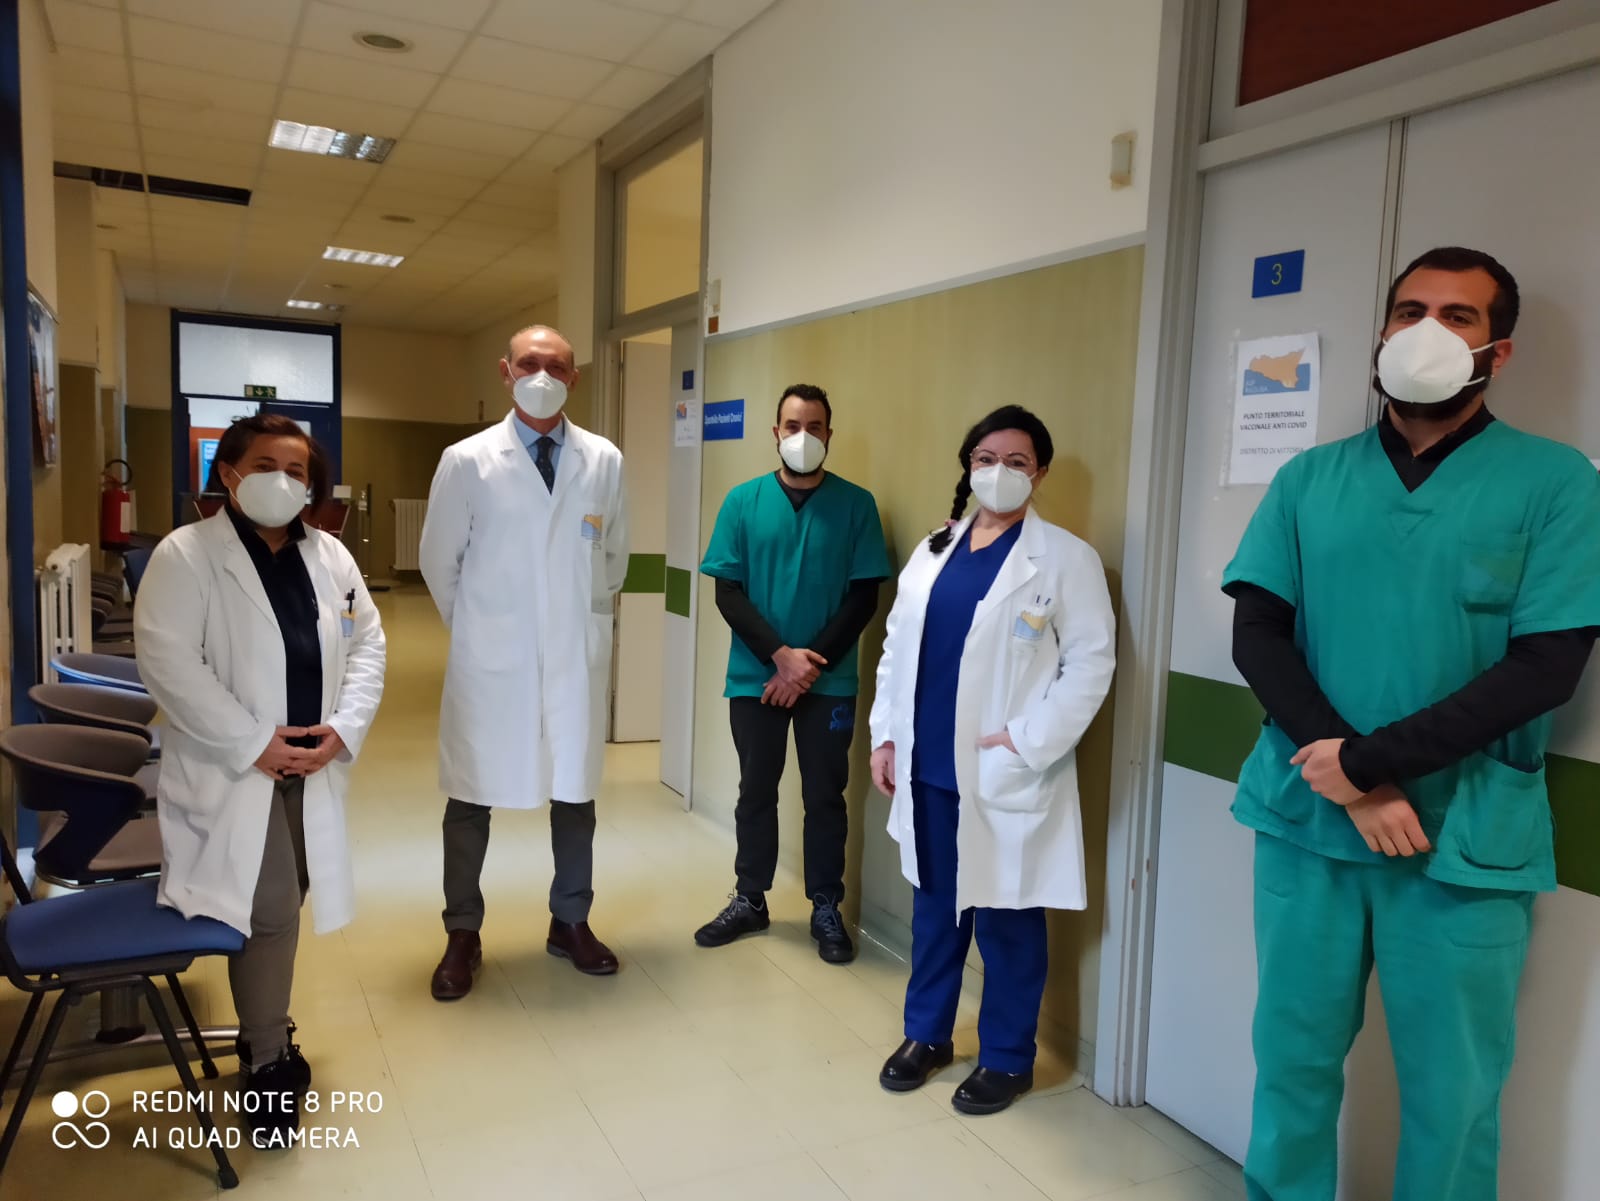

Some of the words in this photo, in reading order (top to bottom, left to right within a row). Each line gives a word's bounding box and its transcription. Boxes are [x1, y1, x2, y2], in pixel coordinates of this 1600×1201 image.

[1271, 263, 1282, 286] 3
[1243, 412, 1263, 420] PUNTO
[1264, 410, 1305, 419] TERRITORIALE
[1272, 422, 1287, 430] ANTI
[1287, 421, 1307, 429] COVID
[1240, 447, 1268, 455] DISTRETTO
[1269, 447, 1276, 455] DI
